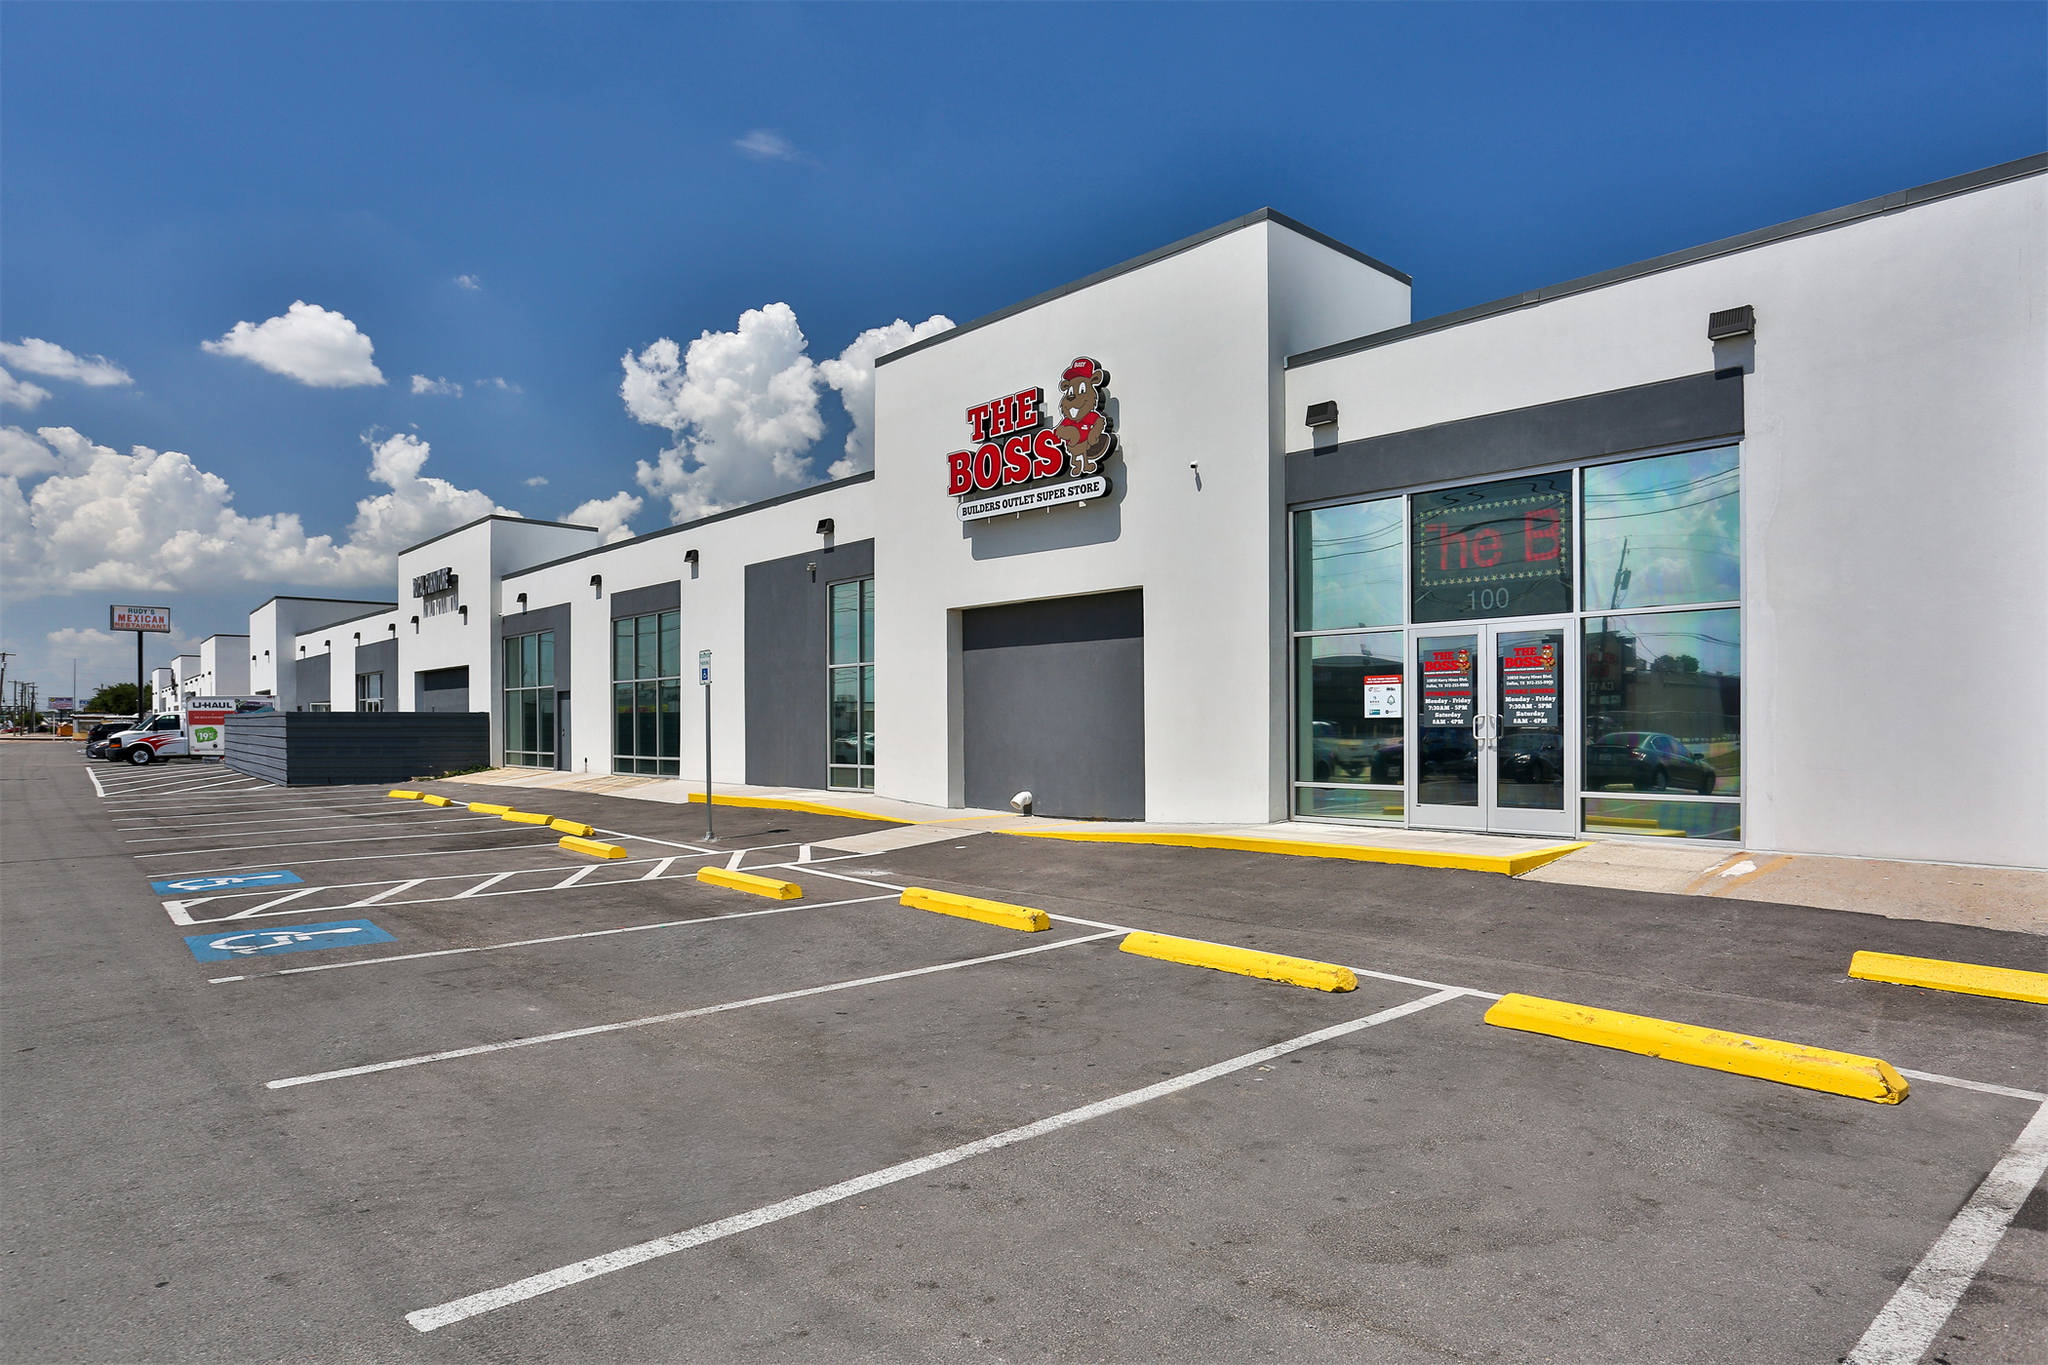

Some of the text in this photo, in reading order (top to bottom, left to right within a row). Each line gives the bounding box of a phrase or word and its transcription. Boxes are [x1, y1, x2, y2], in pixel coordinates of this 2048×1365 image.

[966, 387, 1038, 443] THE
[947, 429, 1063, 496] BOSS
[962, 481, 1100, 516] BUILDERS OUTLET SUPER STORE
[1467, 587, 1510, 610] 100
[118, 614, 165, 624] MEXICAN
[1433, 652, 1454, 660] THE
[1513, 647, 1537, 656] THE
[1425, 661, 1459, 671] BOSS
[1505, 656, 1542, 667] BOSS
